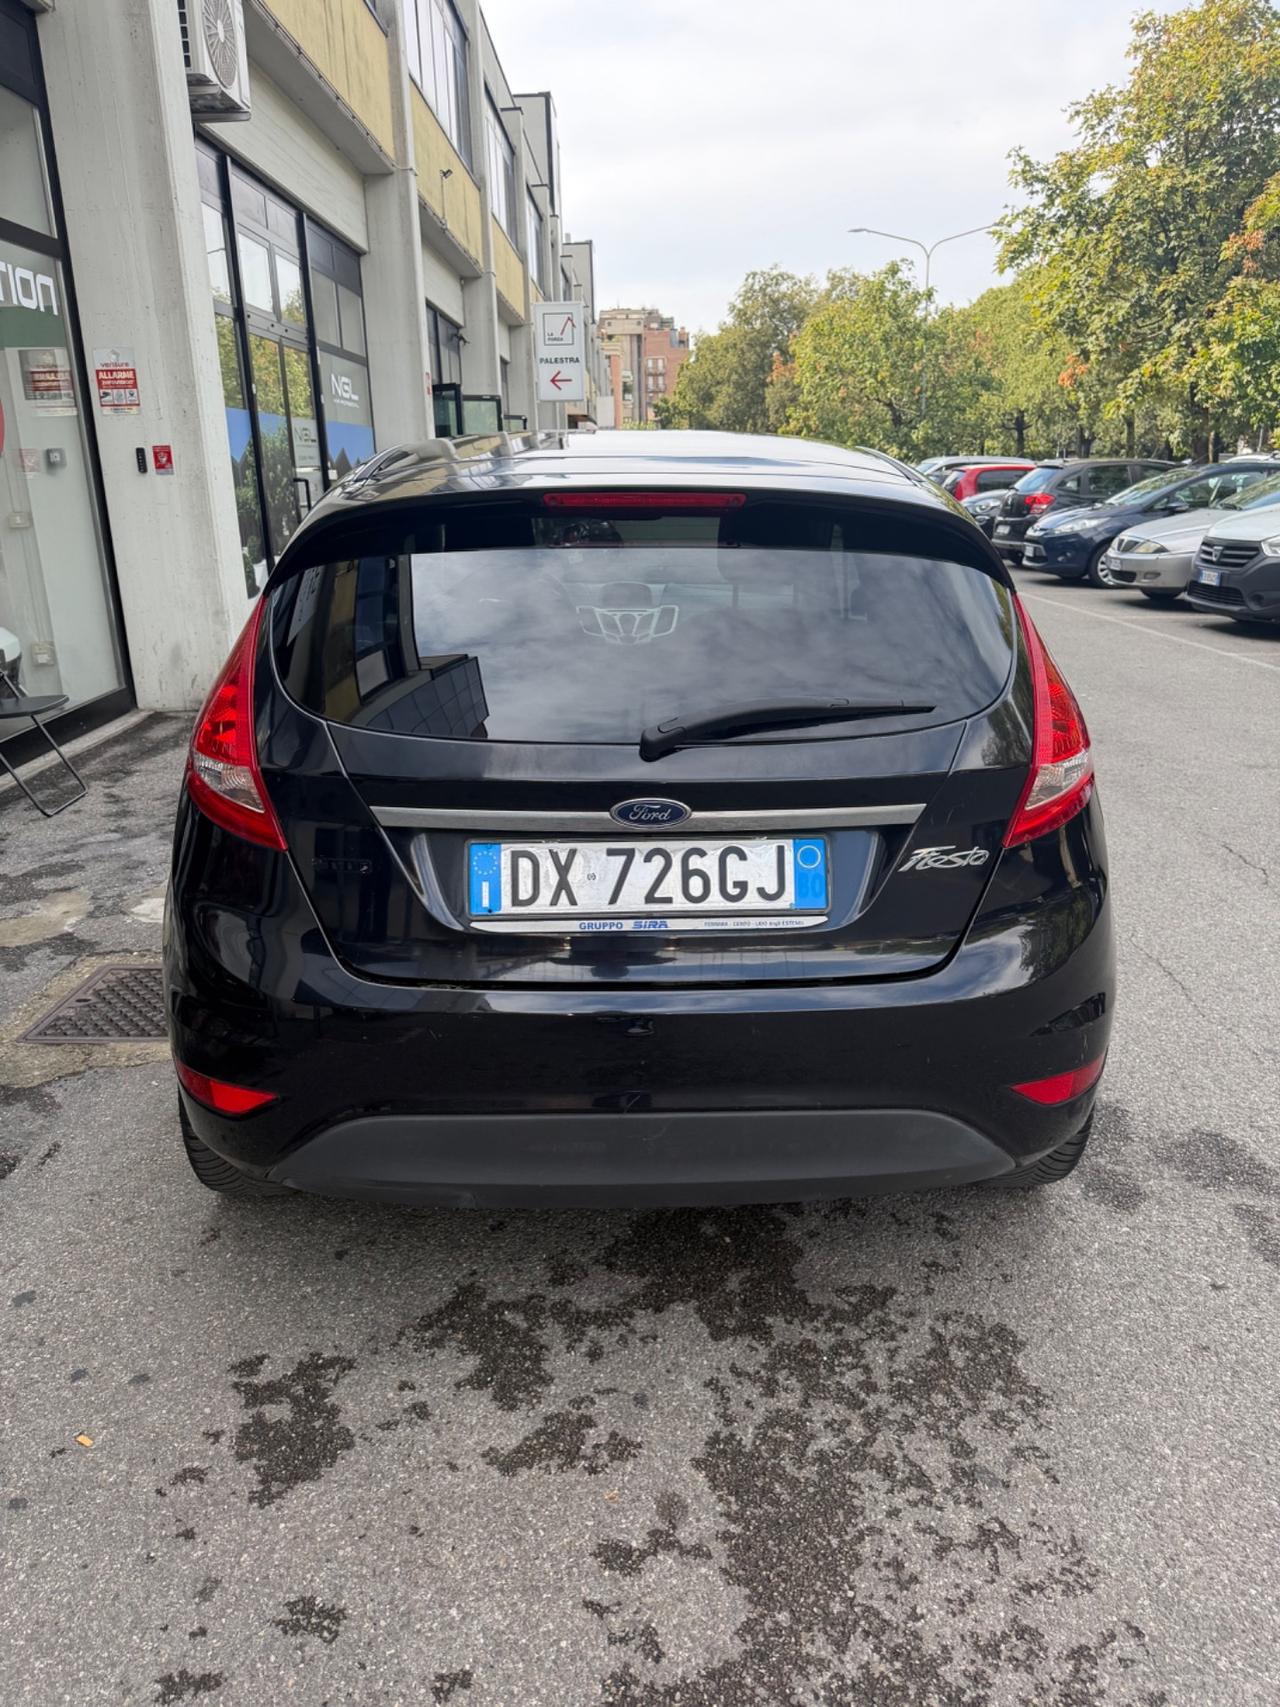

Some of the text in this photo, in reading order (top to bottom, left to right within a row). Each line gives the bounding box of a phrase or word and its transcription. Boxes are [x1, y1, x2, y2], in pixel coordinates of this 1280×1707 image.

[98, 370, 135, 380] ALLARME
[331, 373, 359, 401] NGL
[628, 803, 670, 821] Ford
[898, 845, 989, 872] Fiesta
[510, 845, 786, 907] DX 726GJ
[579, 920, 669, 930] GRUPPO SIRA
